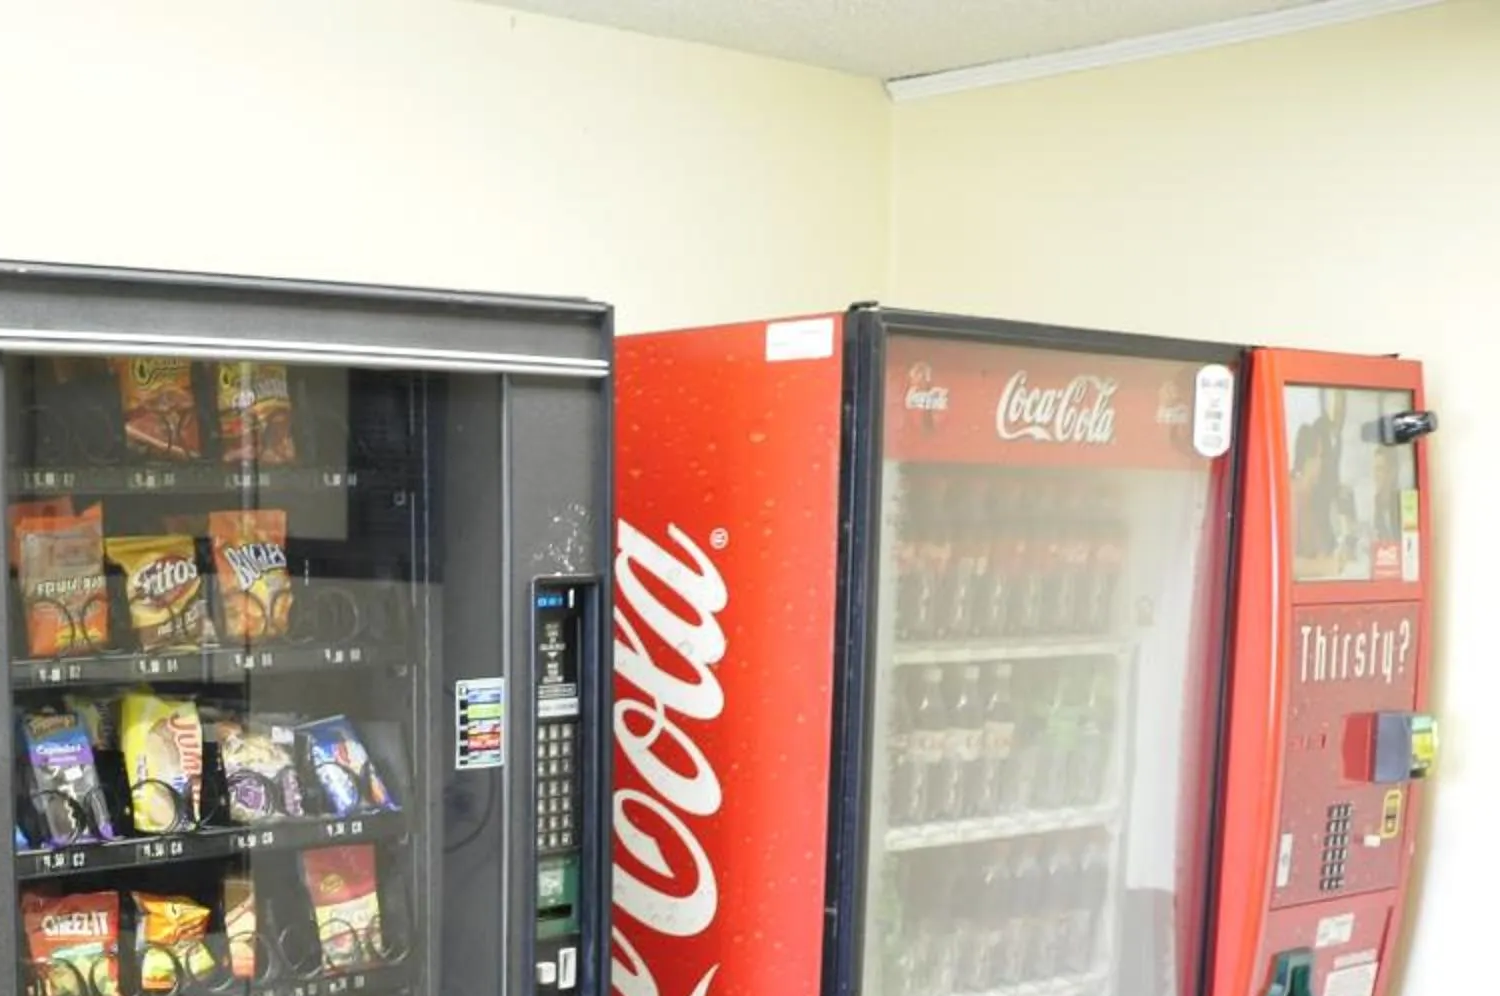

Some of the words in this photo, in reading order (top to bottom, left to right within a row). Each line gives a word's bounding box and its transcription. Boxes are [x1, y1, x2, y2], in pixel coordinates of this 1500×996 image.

[996, 370, 1118, 443] Coca-Cola
[132, 557, 197, 598] Fritos
[1301, 620, 1411, 683] Thirsty?
